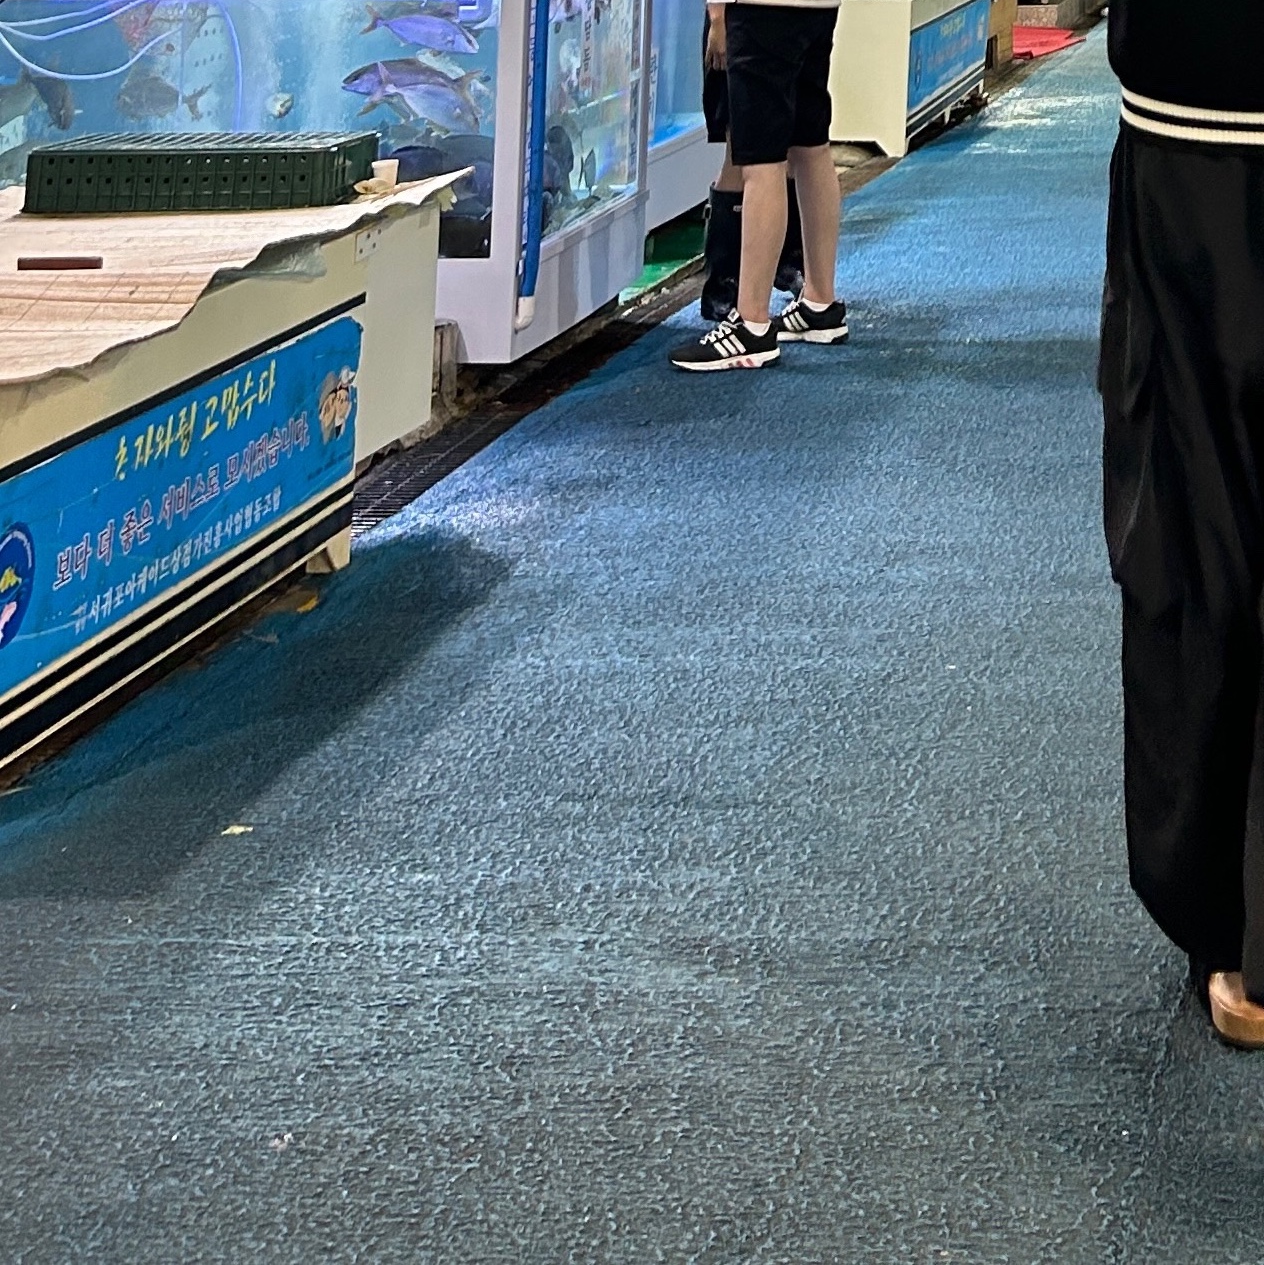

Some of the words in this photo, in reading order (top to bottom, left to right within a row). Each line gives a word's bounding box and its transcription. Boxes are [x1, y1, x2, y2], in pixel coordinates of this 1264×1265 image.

[53, 533, 93, 591] 보다
[96, 519, 116, 567] 더
[119, 498, 154, 556] 좋은
[156, 465, 221, 531] 서비스로
